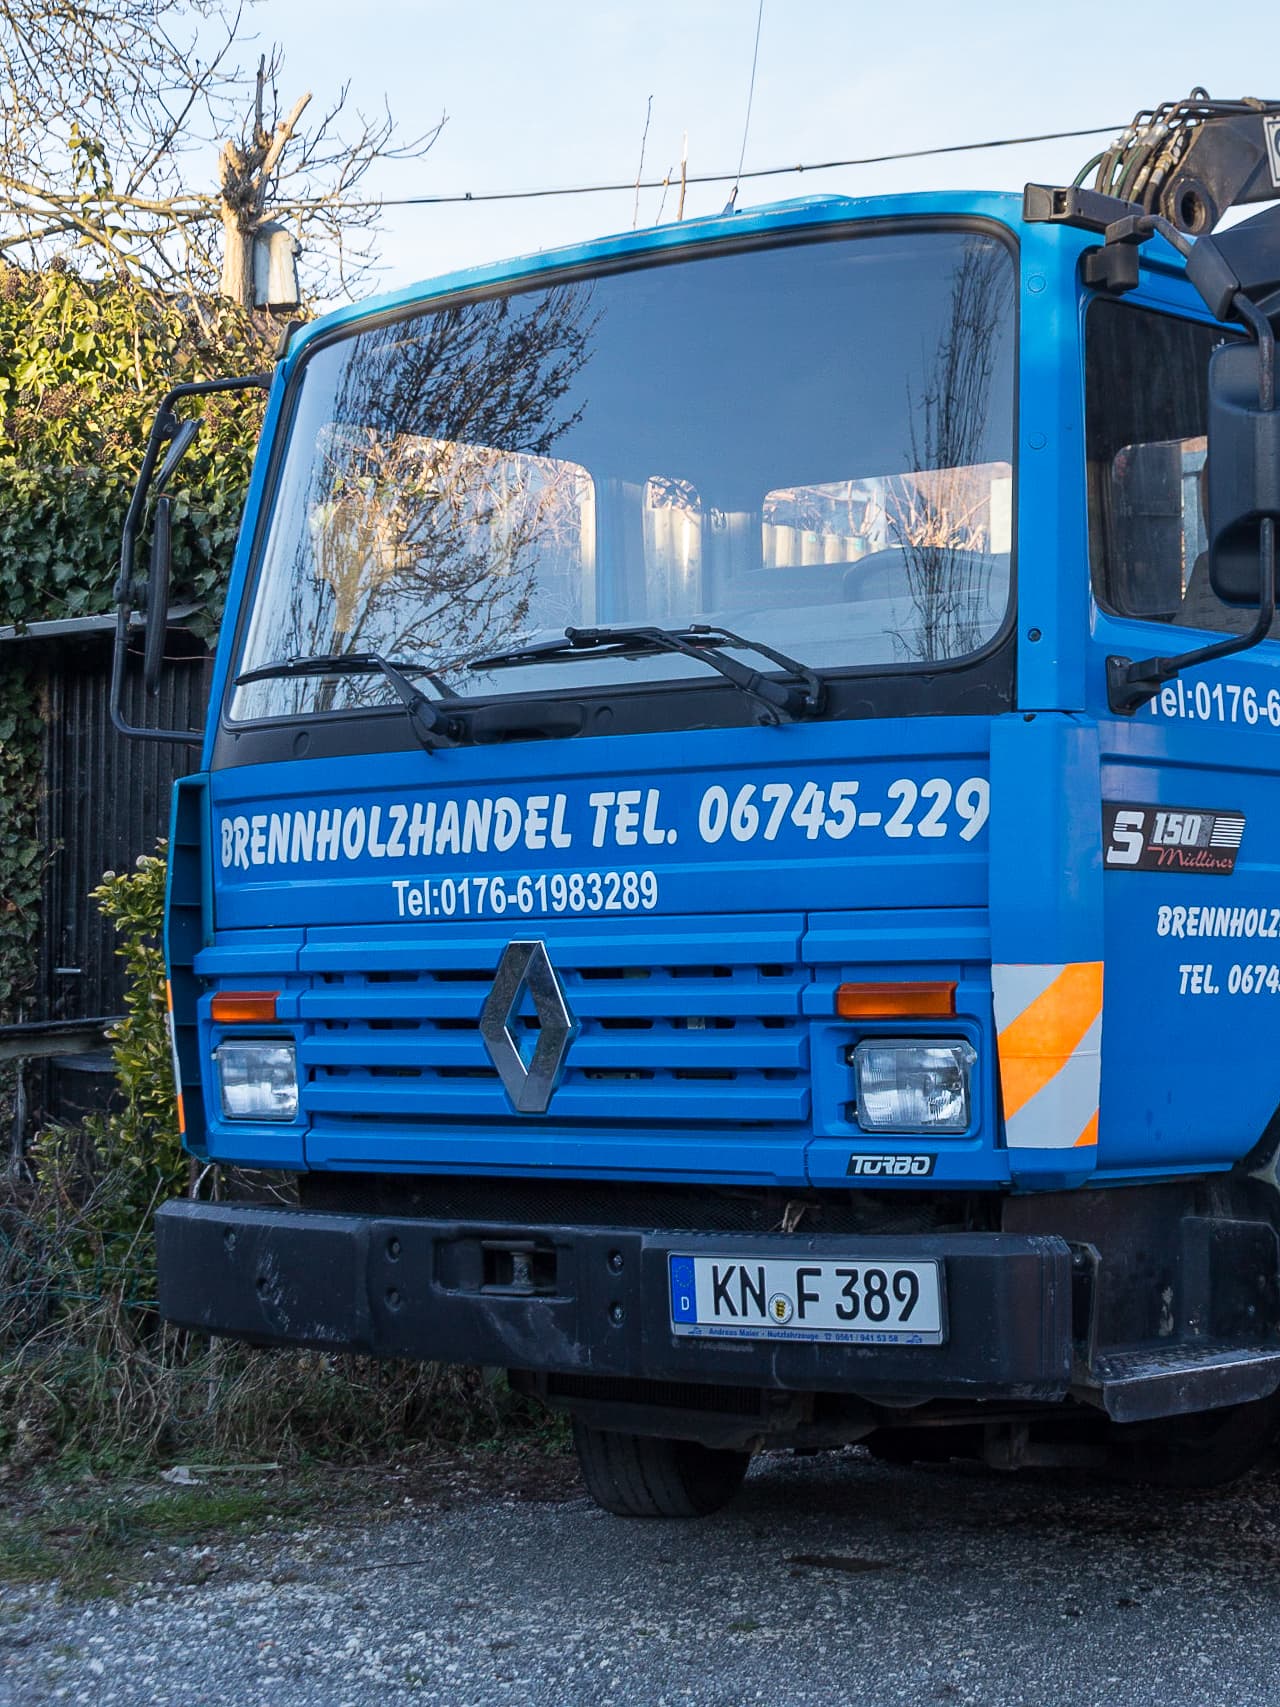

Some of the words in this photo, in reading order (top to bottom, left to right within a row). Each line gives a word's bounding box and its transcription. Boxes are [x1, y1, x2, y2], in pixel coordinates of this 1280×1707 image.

[222, 793, 572, 869] BRENNHOLZHANDEL
[589, 788, 678, 848] TEL.
[698, 777, 991, 842] 06745-229
[1106, 810, 1145, 865] S
[1153, 812, 1202, 846] 150
[1147, 847, 1233, 869] Midliner
[391, 870, 658, 917] Tel:0176-61983289
[1179, 964, 1220, 995] TEL.
[851, 1155, 930, 1175] TURBO
[681, 1296, 690, 1311] D
[712, 1265, 766, 1317] KN
[796, 1267, 822, 1319] F
[835, 1269, 919, 1322] 389
